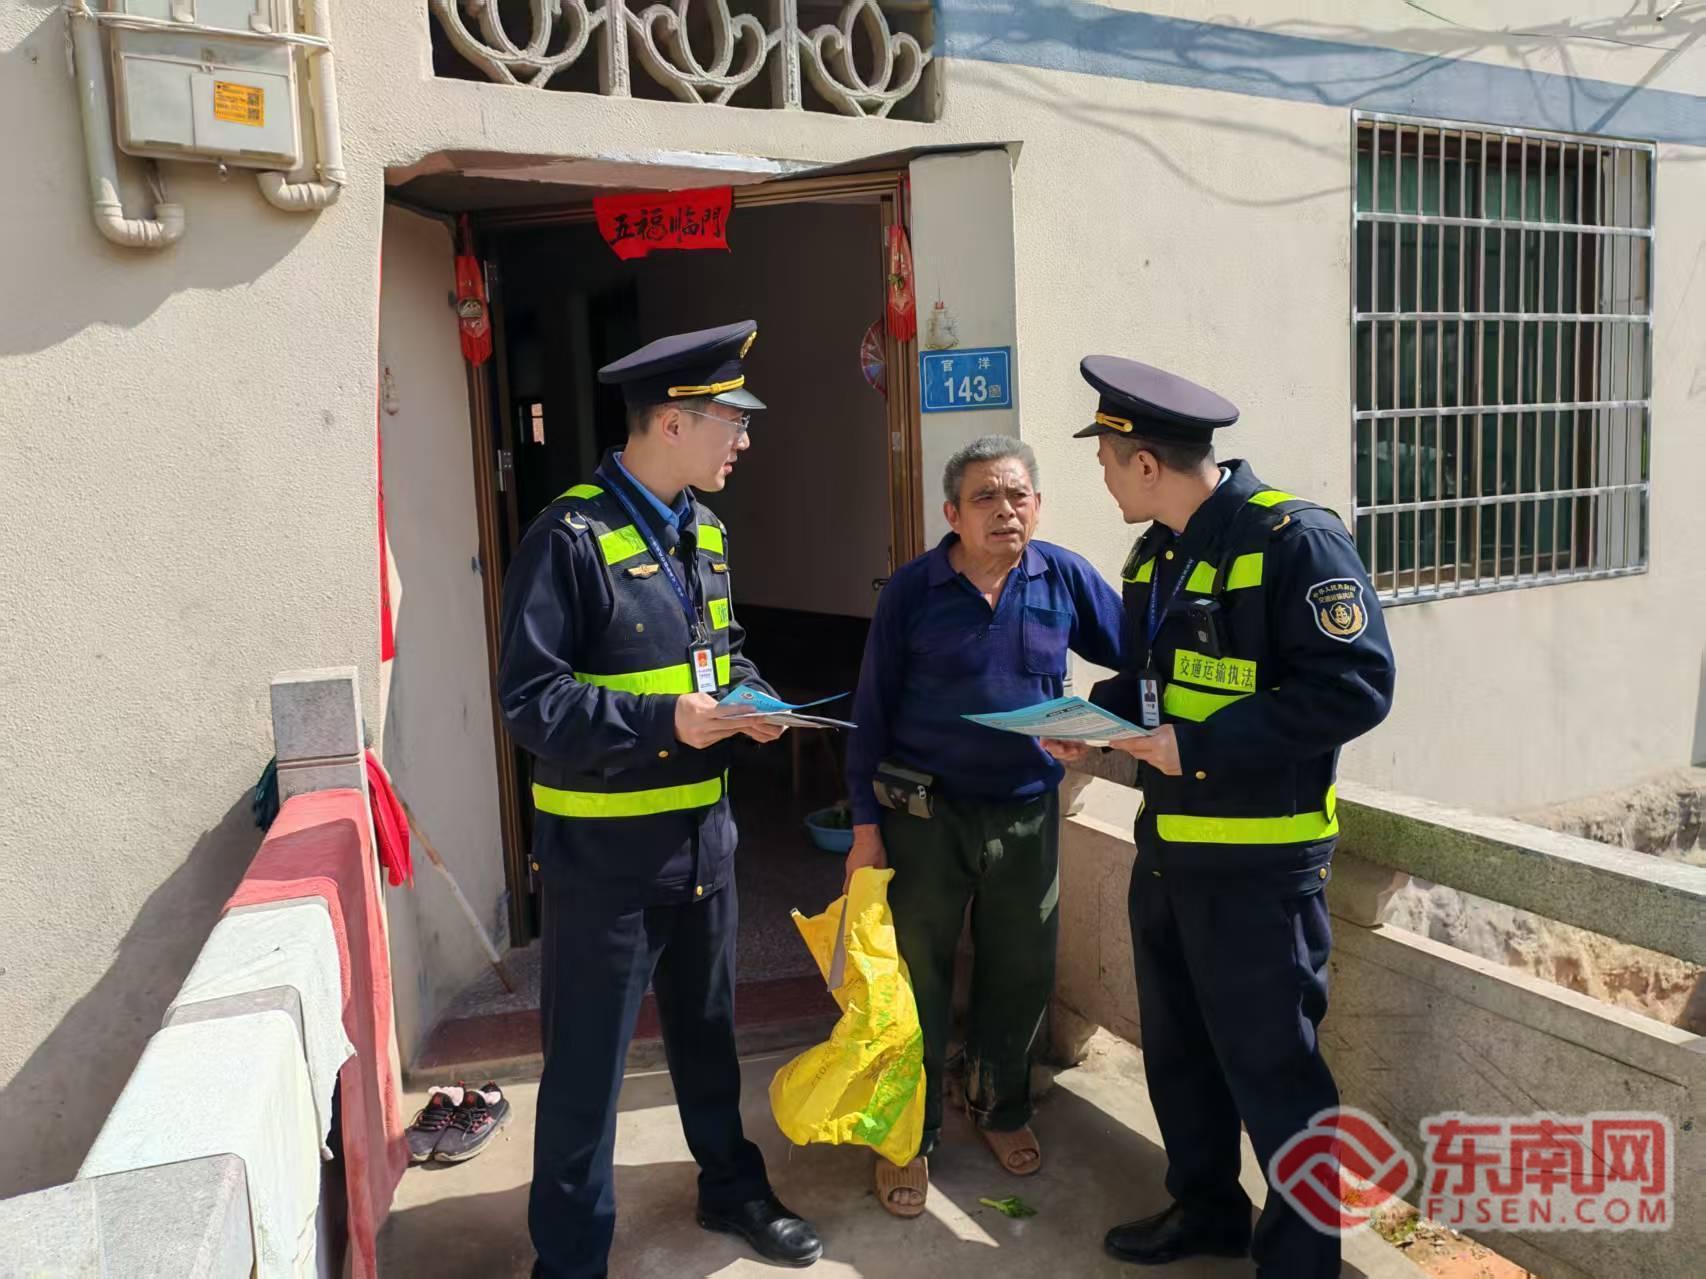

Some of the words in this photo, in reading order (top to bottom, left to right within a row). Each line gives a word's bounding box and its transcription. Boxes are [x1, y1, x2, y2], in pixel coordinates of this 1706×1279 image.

[944, 375, 987, 403] 143
[1180, 655, 1253, 688] 交通运输执法
